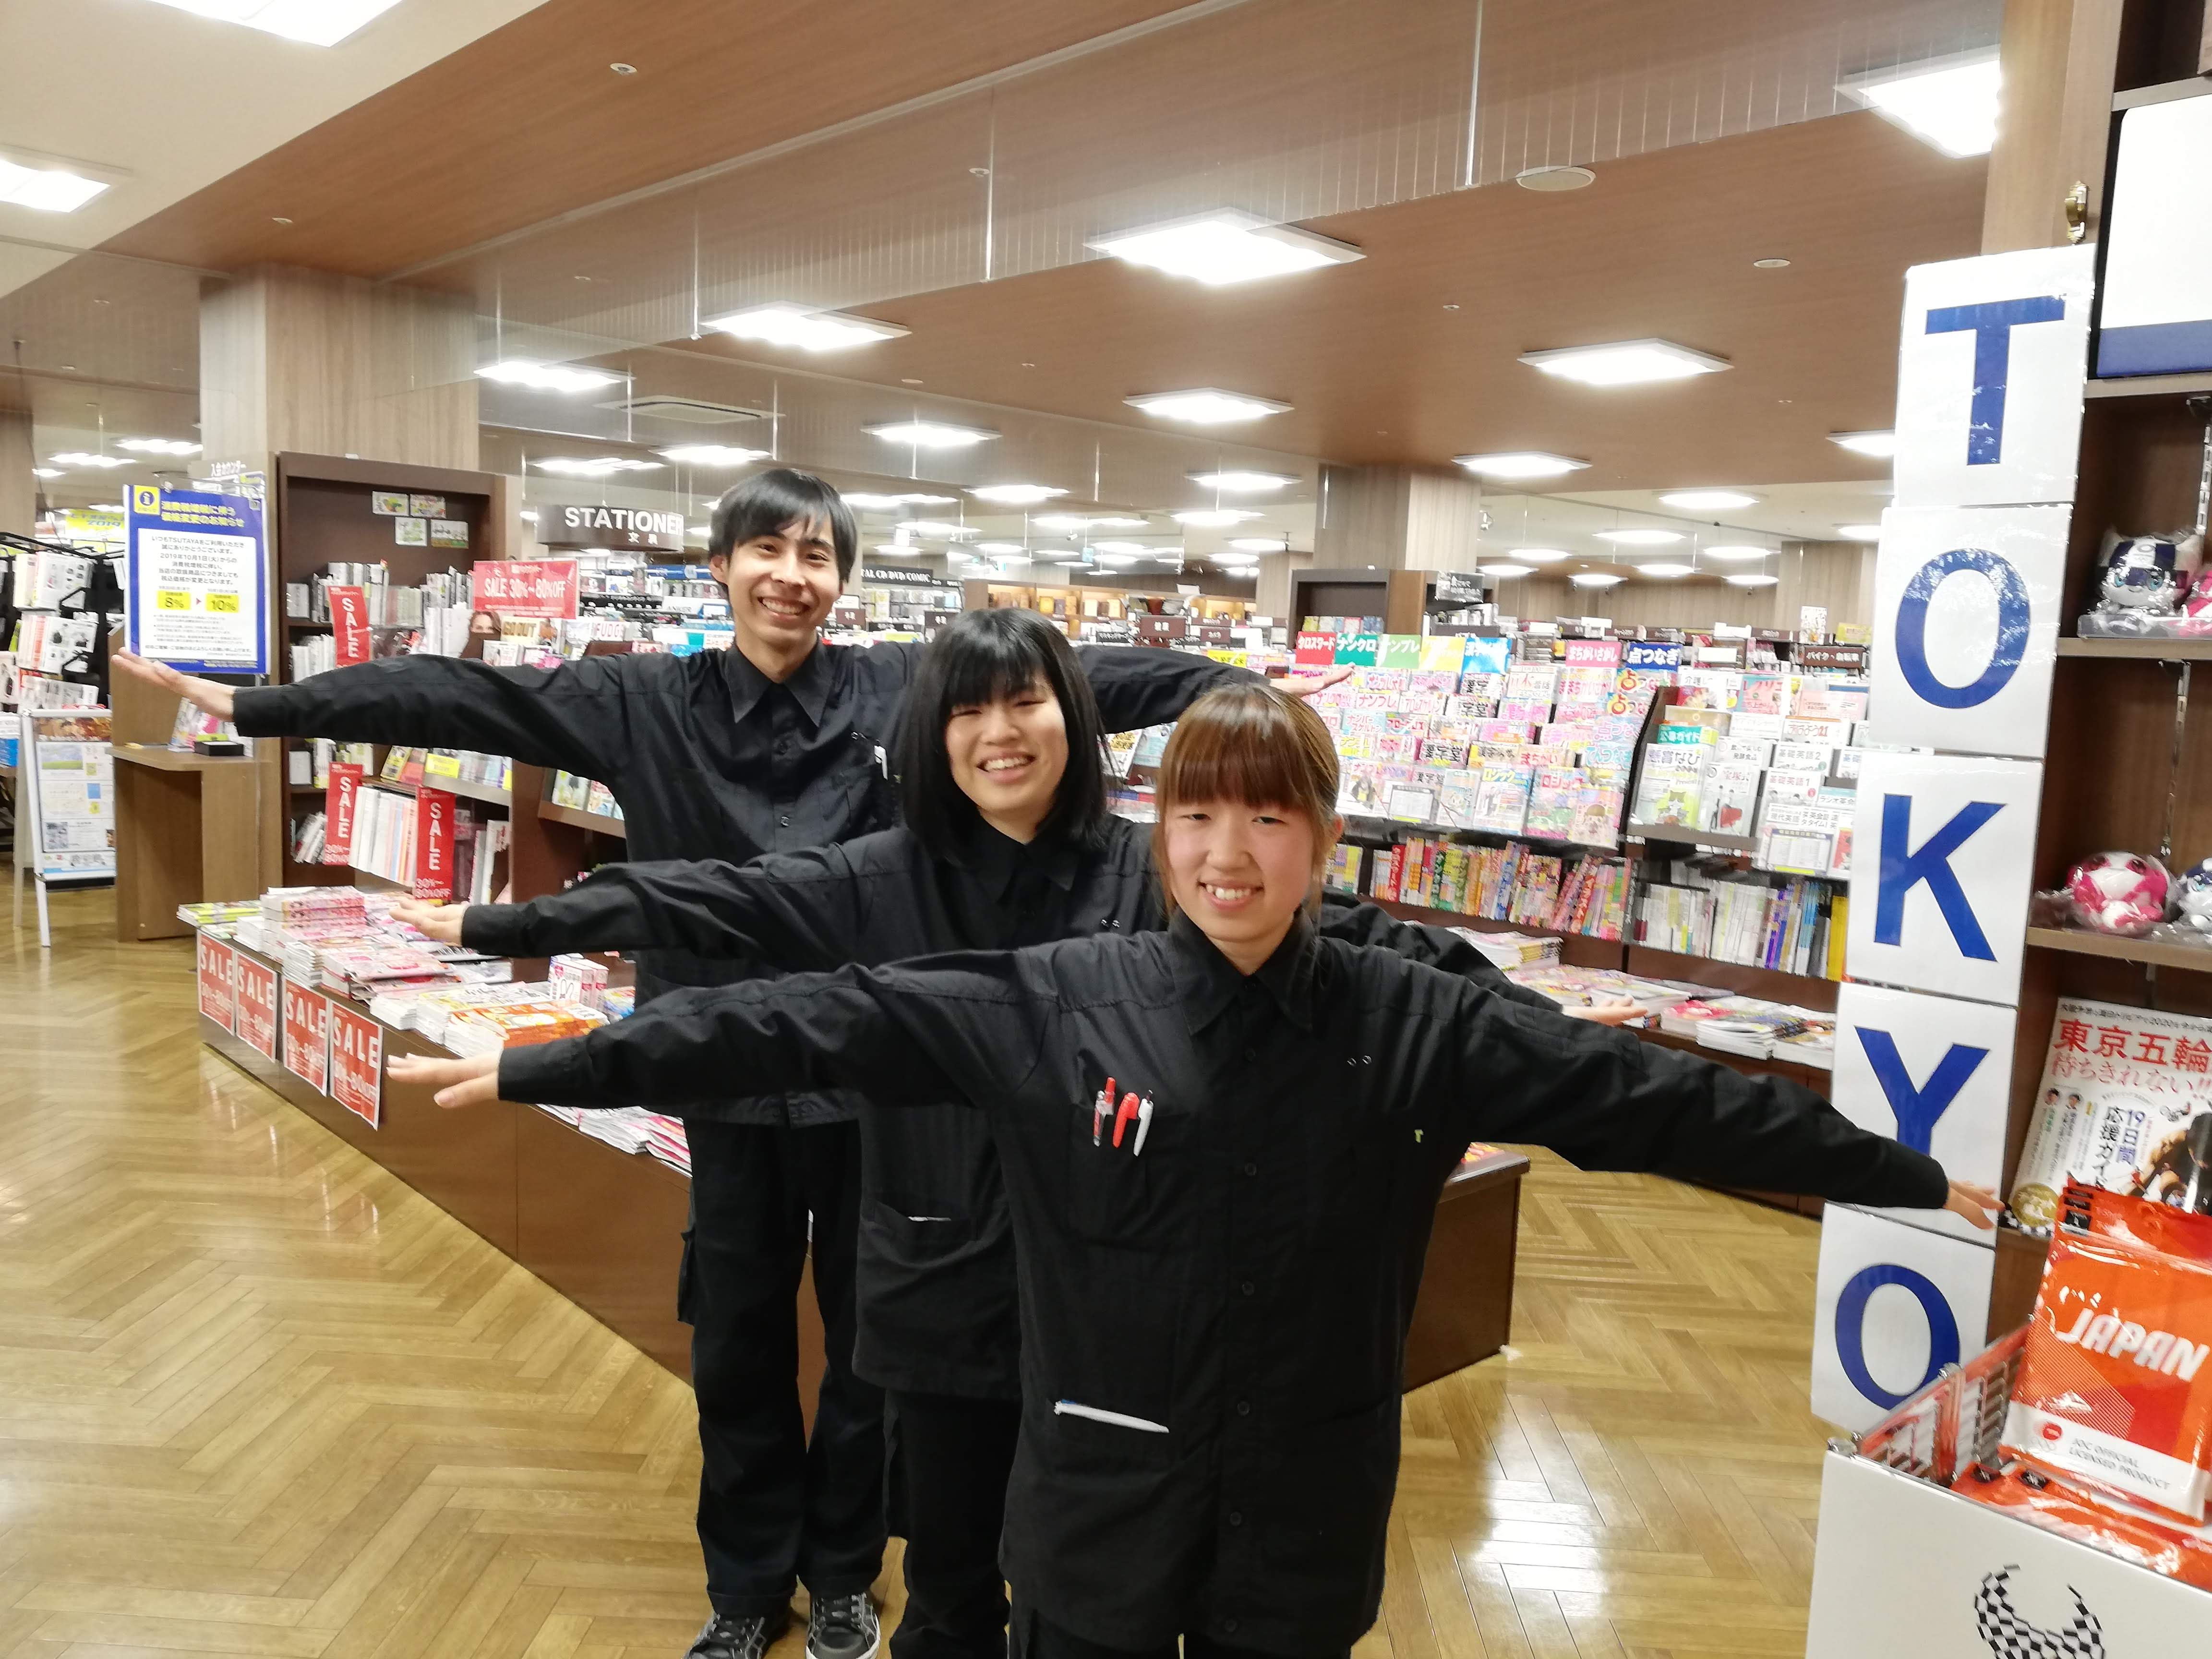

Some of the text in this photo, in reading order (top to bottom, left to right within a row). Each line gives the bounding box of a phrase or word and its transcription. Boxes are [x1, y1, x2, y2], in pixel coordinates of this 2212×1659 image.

[628, 531, 658, 545] 文具
[484, 577, 508, 598] SALE
[341, 597, 360, 658] SALE
[1336, 633, 1377, 655] ナンクロ
[1568, 645, 1617, 662] まちがいさがし
[1627, 646, 1681, 666] 点つなぎ
[1779, 748, 1821, 760] 基礎英語2
[1769, 775, 1810, 786] 基礎英語1
[337, 776, 352, 838] SALE
[429, 802, 443, 871] SALE
[1834, 295, 2066, 1412] TOKYO
[200, 944, 233, 986] SALE
[238, 965, 274, 1010] SALE
[286, 991, 326, 1039] SALE
[334, 1016, 378, 1069] SALE
[2052, 1019, 2212, 1074] 東京五輪
[2056, 1307, 2210, 1382] JAPAN
[2072, 1438, 2093, 1451] JOC
[2118, 1465, 2170, 1490] PRODUCT
